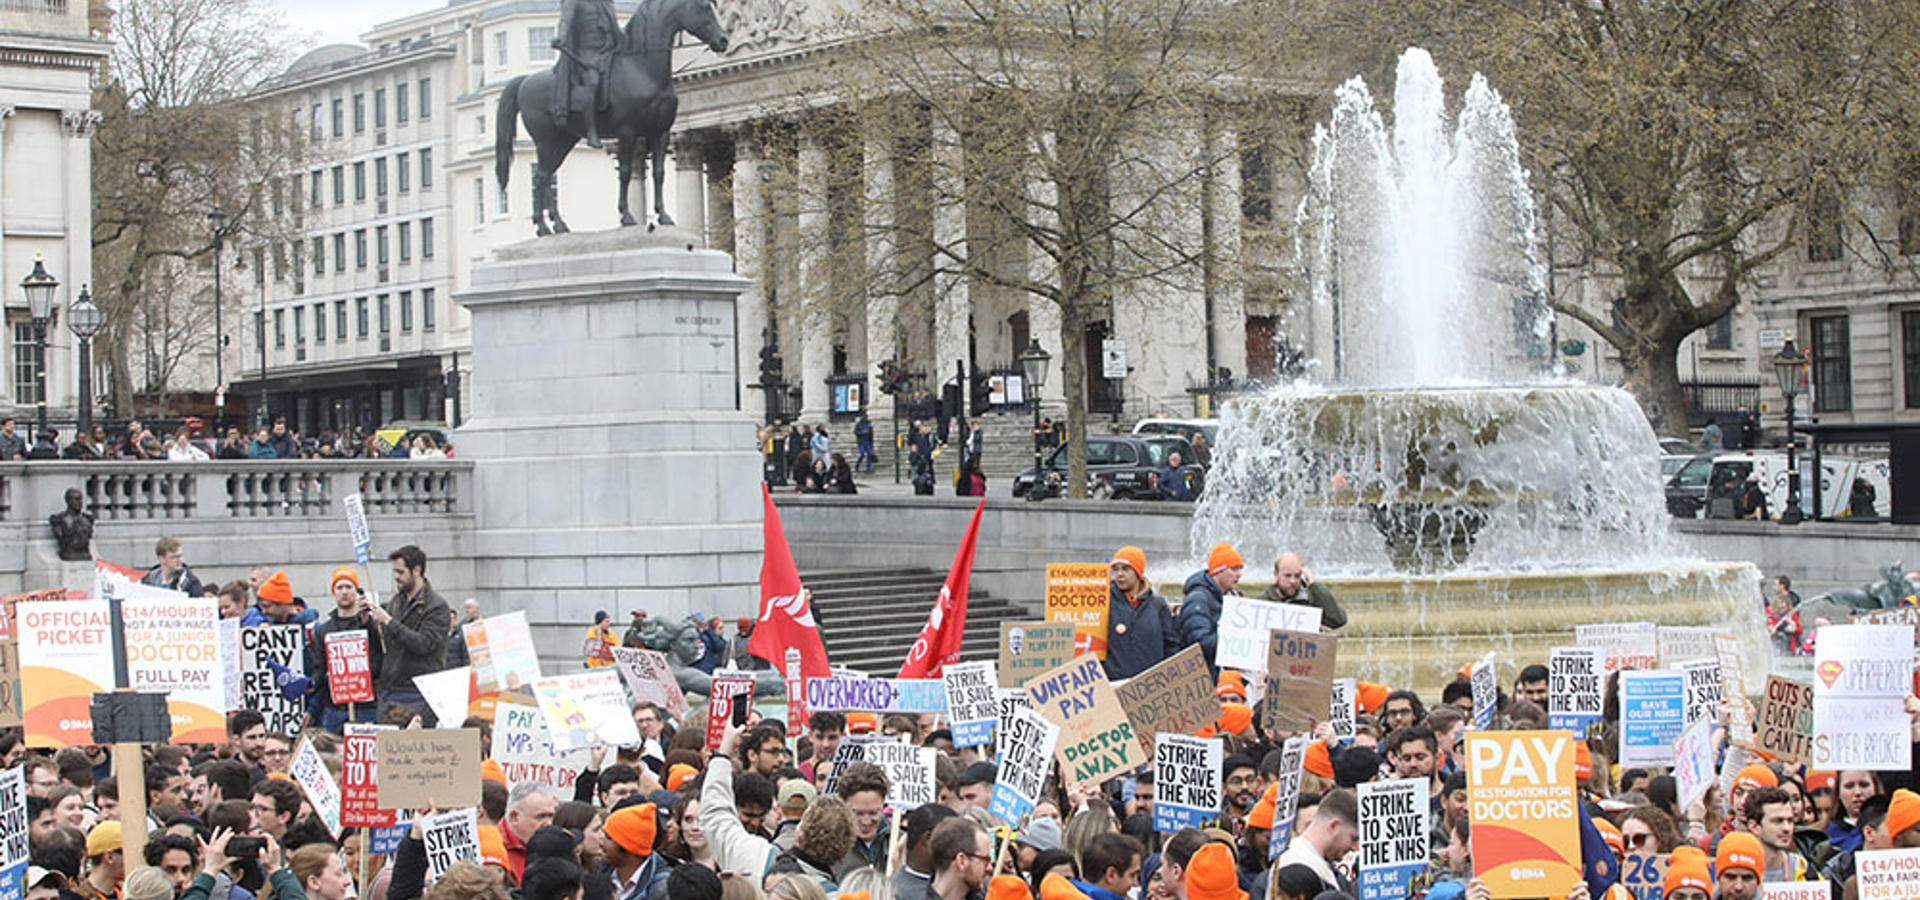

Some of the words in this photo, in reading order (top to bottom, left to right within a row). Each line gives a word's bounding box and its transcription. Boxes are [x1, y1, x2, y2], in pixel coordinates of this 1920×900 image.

[1049, 594, 1106, 607] DOCTOR
[26, 610, 111, 628] OFFICIAL
[123, 606, 197, 619] £14/HOUR
[201, 606, 214, 618] IS
[1054, 611, 1079, 622] FULL
[1082, 611, 1101, 622] PAY
[1232, 601, 1308, 632] STEVE
[1876, 606, 1920, 625] TREA
[149, 620, 156, 629] A
[159, 620, 181, 629] FAIR
[185, 620, 213, 630] WAGE
[37, 629, 106, 646] PICKET
[156, 631, 163, 641] A
[167, 631, 216, 642] JUNIOR
[1223, 634, 1252, 658] YOU
[127, 643, 216, 662] DOCTOR
[328, 640, 367, 657] STRIKE
[256, 651, 292, 669] PAY
[330, 658, 345, 675] TO
[348, 656, 369, 672] WIN
[1551, 657, 1594, 675] STRIKE
[136, 669, 177, 683] FULL
[181, 669, 210, 682] PAY
[946, 670, 987, 690] STRIKE
[1031, 658, 1103, 705] UNFAIR
[1119, 652, 1205, 707] NDERVALUED
[1551, 675, 1566, 693] TO
[1569, 675, 1599, 694] SAVE
[1691, 667, 1722, 687] RIKE
[949, 688, 964, 705] TO
[967, 686, 995, 703] SAVE
[1059, 686, 1095, 720] PAY
[1128, 673, 1214, 728] NDERPAID
[1551, 694, 1573, 712] THE
[1576, 694, 1601, 712] NHS
[1697, 686, 1722, 704] SAV
[1769, 680, 1799, 706] CUTS
[712, 698, 728, 717] TO
[951, 704, 974, 722] THE
[976, 700, 999, 718] NHS
[1628, 709, 1652, 719] OUR
[1766, 701, 1797, 729] EVEN
[507, 710, 536, 729] PAY
[347, 737, 376, 762] STR
[506, 732, 534, 754] MPs
[836, 744, 865, 761] STRI
[1008, 738, 1025, 763] TO
[1064, 722, 1134, 762] DOCTOR
[868, 744, 922, 765] STRIKE
[1074, 743, 1130, 783] AWAY
[1157, 743, 1208, 768] STRIKE
[1469, 737, 1567, 786] PAY
[345, 762, 366, 785] TO
[558, 767, 577, 788] DR
[892, 764, 929, 785] SAVE
[1157, 763, 1176, 783] TO
[1180, 765, 1215, 789] SAVE
[901, 783, 932, 804] NHS
[1156, 781, 1183, 804] THE
[1188, 787, 1217, 808] NHS
[1473, 787, 1547, 799] RESTORATION
[1550, 786, 1572, 797] FOR
[1361, 791, 1415, 818] STRIKE
[1474, 799, 1573, 821] DOCTORS
[426, 821, 472, 852] STRIKE
[1361, 818, 1381, 841] TO
[1386, 814, 1423, 840] SAVE
[1361, 841, 1390, 865] THE
[1395, 837, 1426, 861] NHS
[430, 850, 451, 875] TO
[1625, 853, 1660, 884] 26
[1363, 872, 1381, 884] Kick
[1383, 869, 1398, 882] out
[1863, 873, 1884, 884] NOT
[1887, 873, 1894, 882] A
[1863, 884, 1890, 899] FOR
[1893, 884, 1903, 896] A
